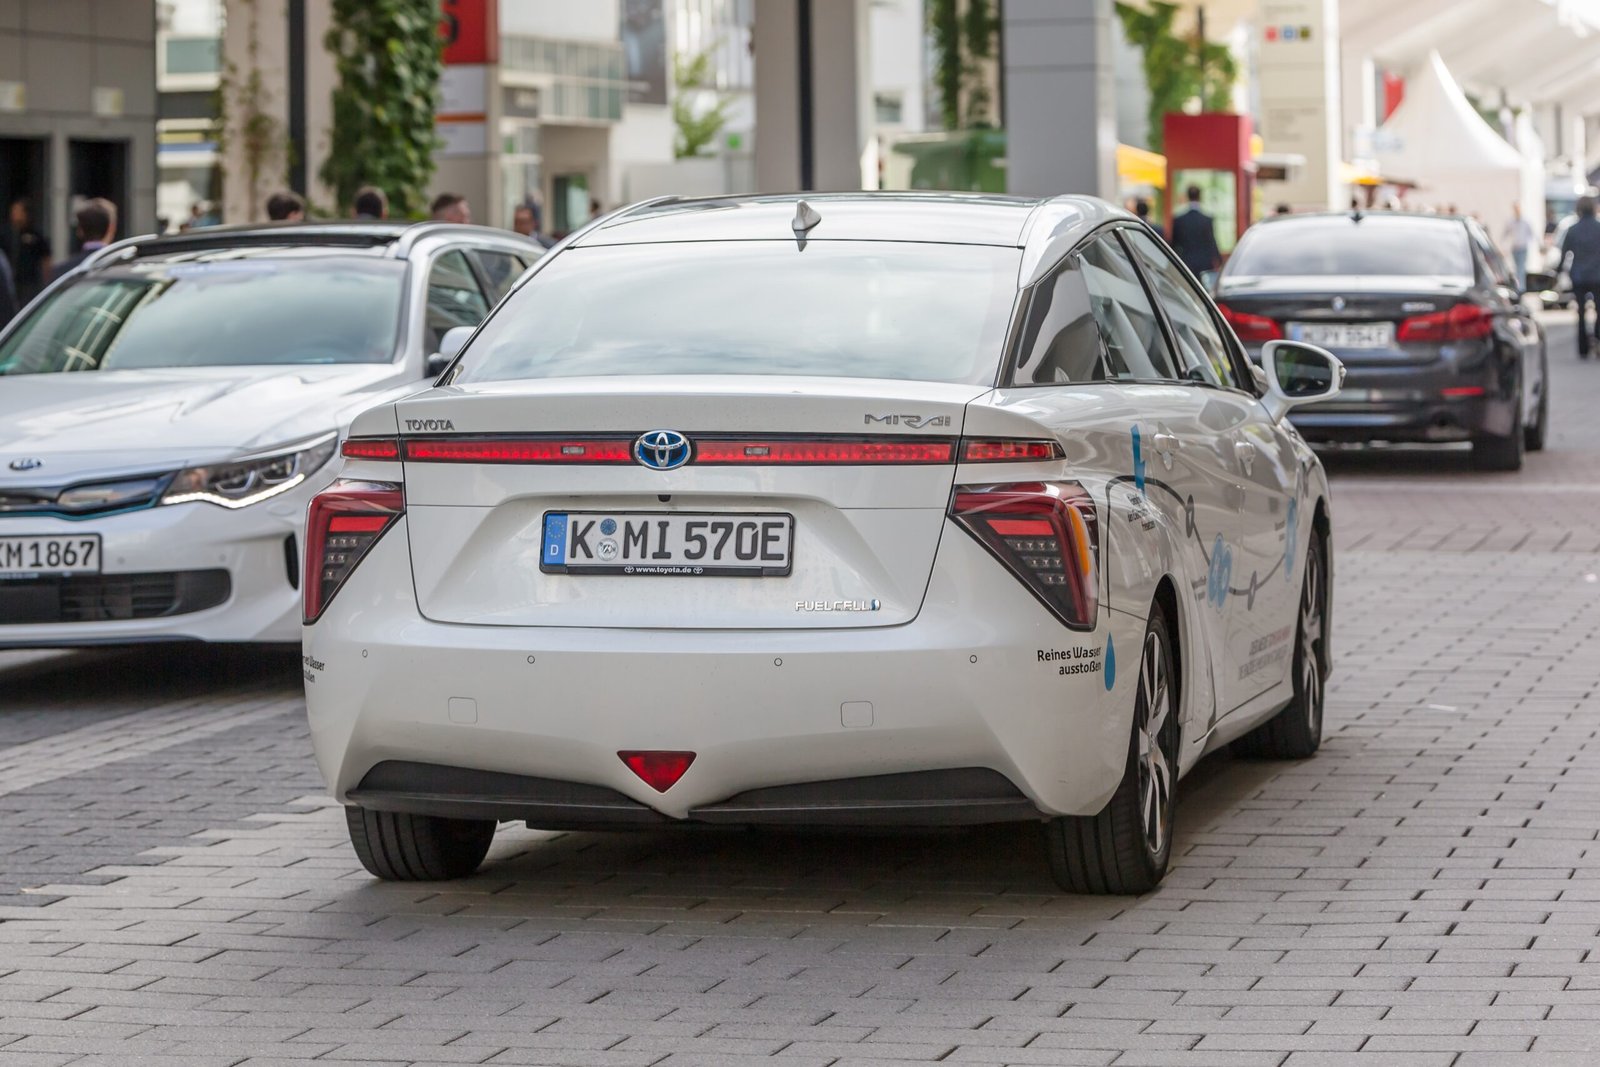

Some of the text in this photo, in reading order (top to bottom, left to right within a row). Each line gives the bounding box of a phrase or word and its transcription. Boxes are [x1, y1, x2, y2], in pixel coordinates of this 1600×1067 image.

[405, 419, 455, 431] TOYOTA
[570, 520, 785, 561] K MI 570E
[29, 541, 95, 568] 1867
[550, 544, 559, 556] D
[636, 566, 692, 575] www.toyota.de
[1037, 646, 1102, 662] Reines Wasser
[1059, 660, 1102, 676] ausstoßen
